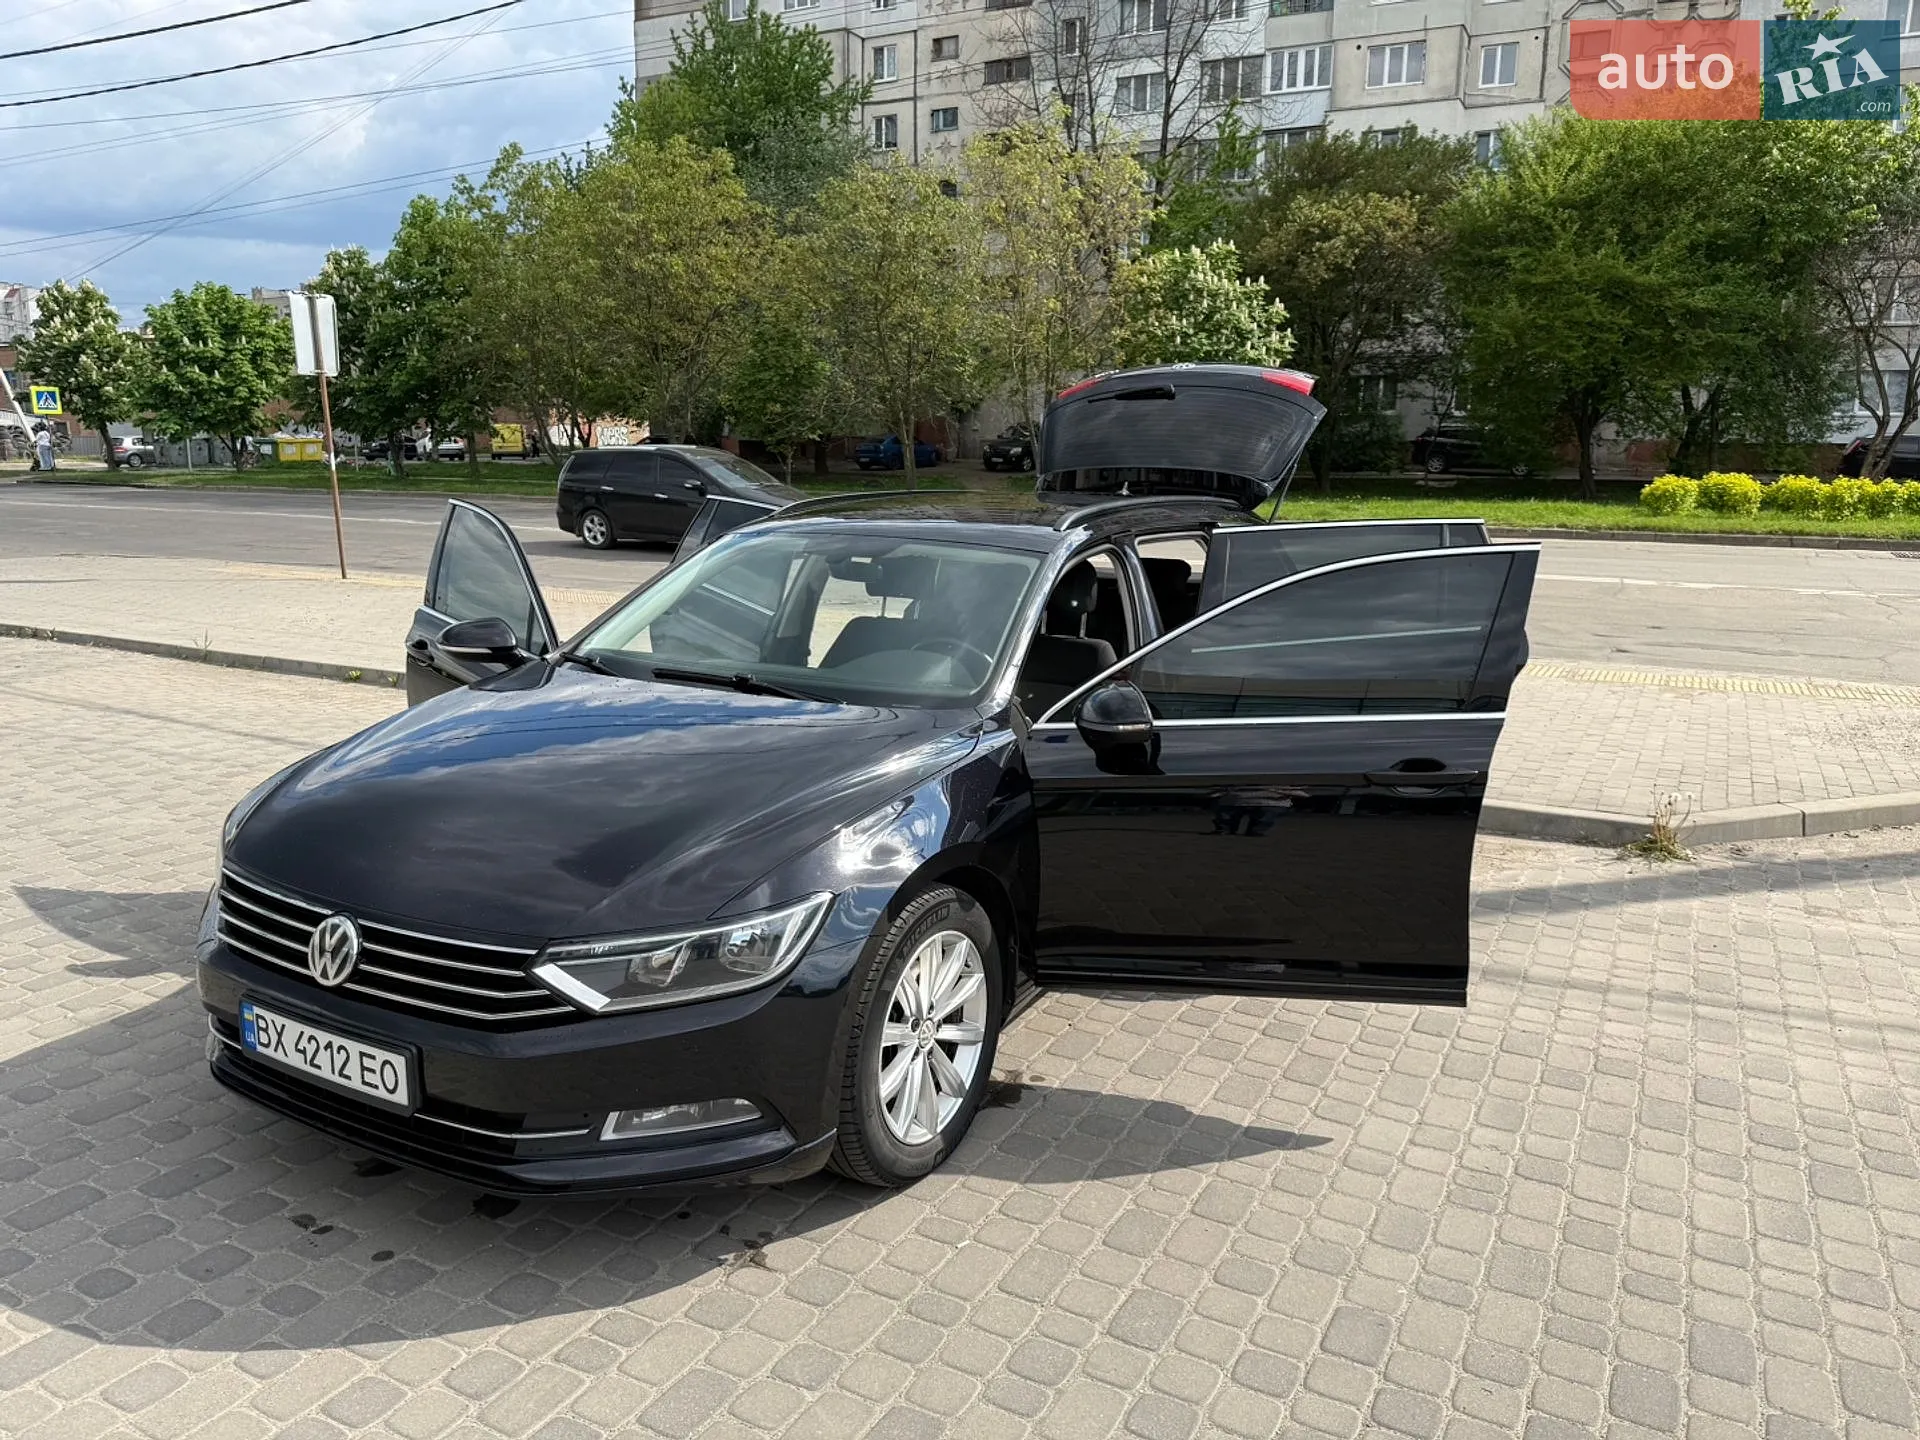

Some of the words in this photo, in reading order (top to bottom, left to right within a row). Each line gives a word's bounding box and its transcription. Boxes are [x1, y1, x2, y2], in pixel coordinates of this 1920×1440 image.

[254, 1013, 288, 1057] BX
[294, 1030, 352, 1081] 4212
[359, 1050, 399, 1095] EO
